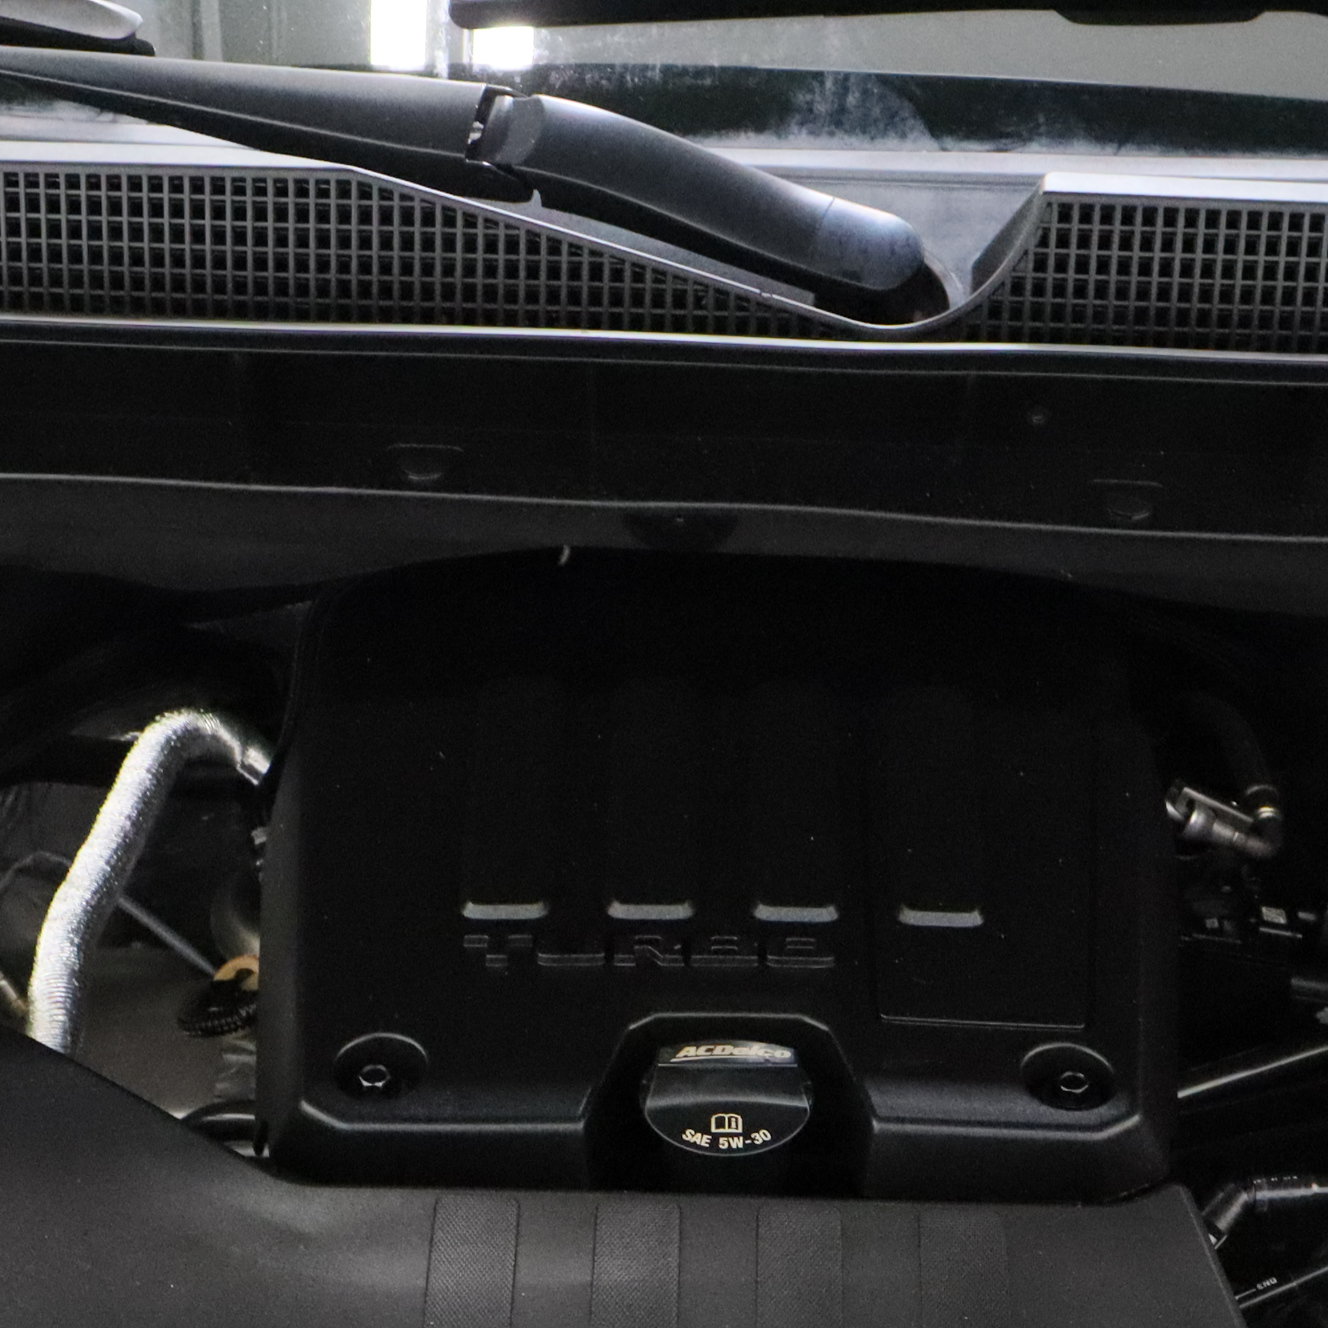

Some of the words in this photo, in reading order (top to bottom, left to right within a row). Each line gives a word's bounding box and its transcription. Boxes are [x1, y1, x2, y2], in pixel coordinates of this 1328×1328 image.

[675, 1045, 792, 1059] ACDelco
[681, 1128, 713, 1148] SAE
[718, 1129, 772, 1149] 5W-30
